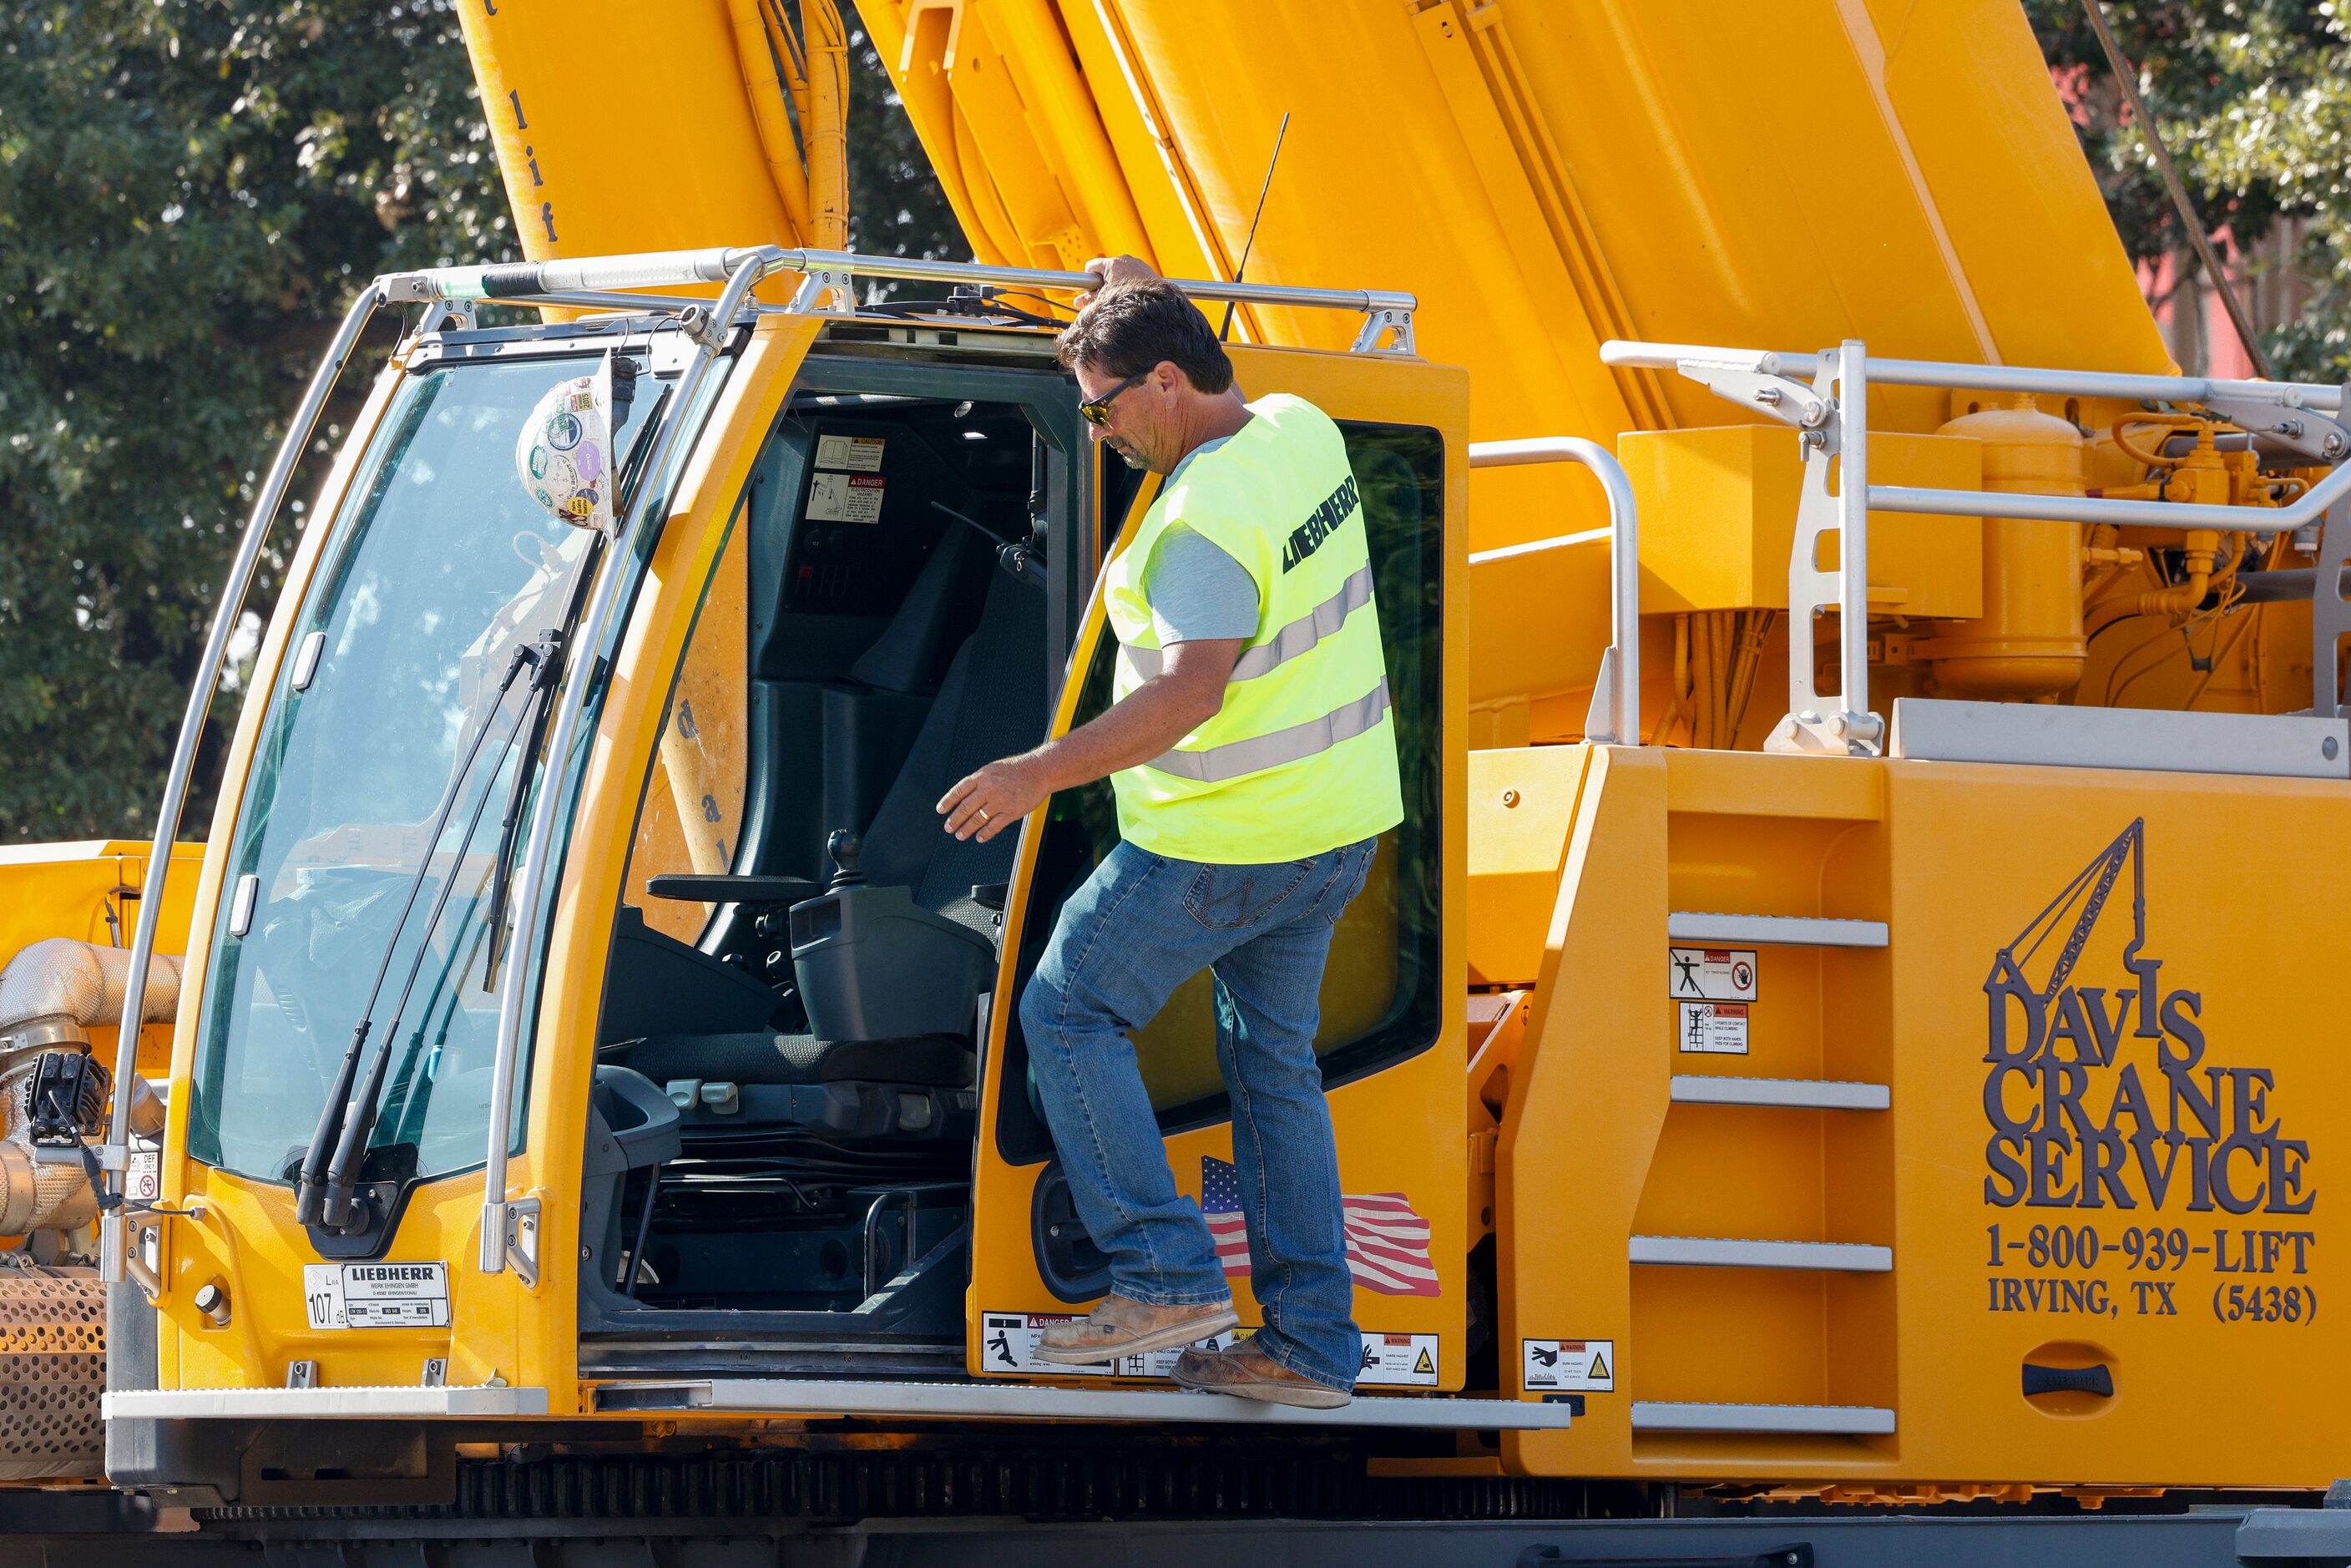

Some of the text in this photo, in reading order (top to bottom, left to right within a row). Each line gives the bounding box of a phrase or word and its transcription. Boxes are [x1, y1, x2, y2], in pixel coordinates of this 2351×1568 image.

[582, 393, 590, 408] 2015
[1282, 474, 1360, 575] LIEBHERR
[1983, 959, 2205, 1070] DAVIS
[1983, 1058, 2282, 1144] CRANE
[144, 1154, 155, 1163] DEF
[1984, 1131, 2317, 1214] SERVICE
[1986, 1223, 2316, 1274] 1-800-939-LIFT
[351, 1267, 434, 1281] LIEBHERR
[308, 1292, 331, 1324] 107
[336, 1310, 345, 1324] dB
[1988, 1278, 2318, 1327] IRVING, TX (5438)
